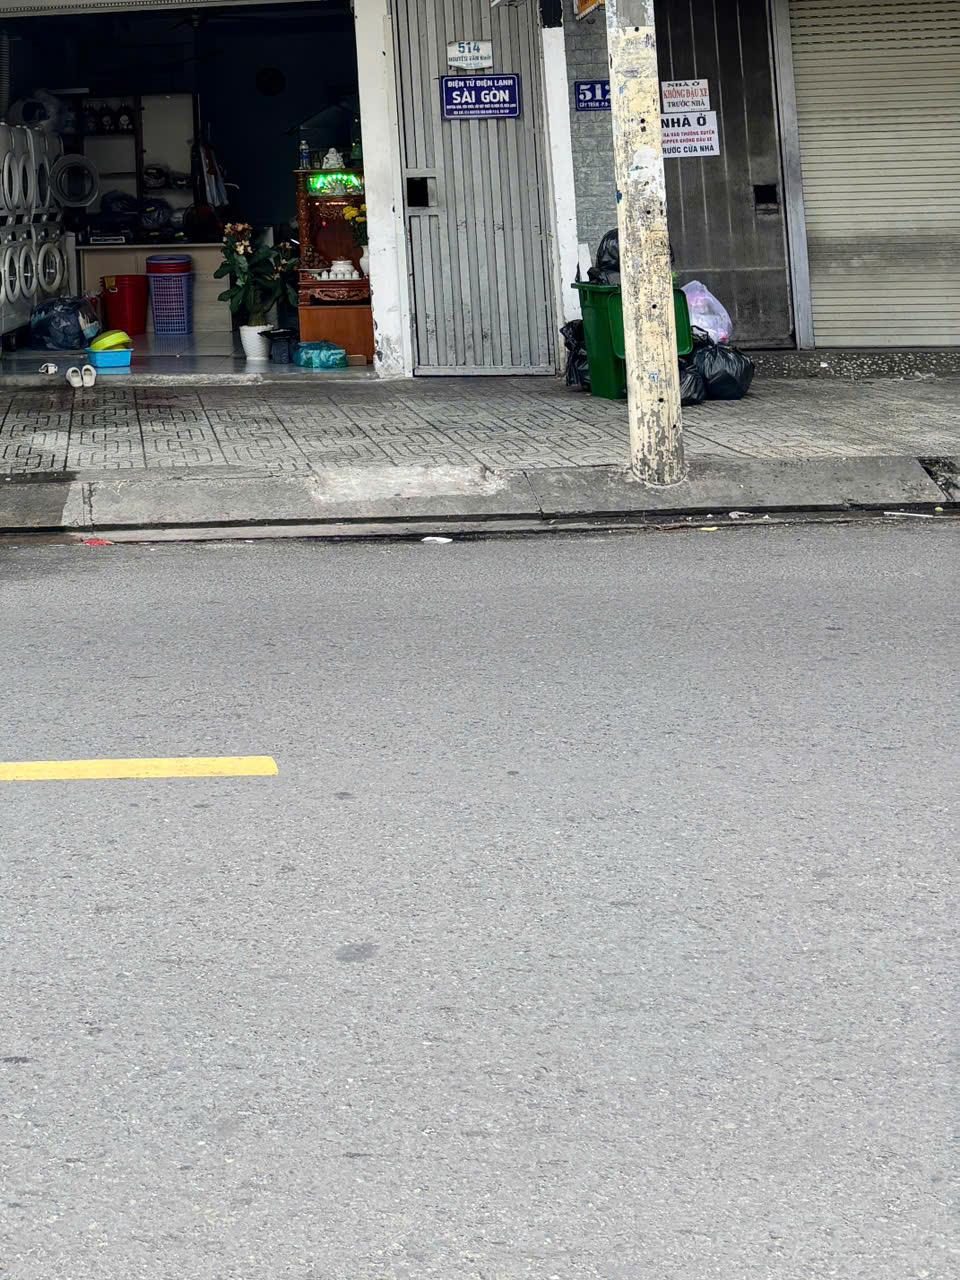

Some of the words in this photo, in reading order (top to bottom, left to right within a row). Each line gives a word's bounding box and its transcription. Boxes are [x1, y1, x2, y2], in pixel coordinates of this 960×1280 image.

[458, 40, 480, 54] 514
[452, 88, 476, 104] SÀI
[481, 87, 509, 103] GÒN
[663, 87, 686, 99] KHÔNG
[700, 88, 708, 97] XE
[667, 98, 690, 108] TRƯỚC
[691, 98, 706, 107] NHÀ
[661, 114, 691, 128] NHÀ
[697, 113, 707, 126] Ở
